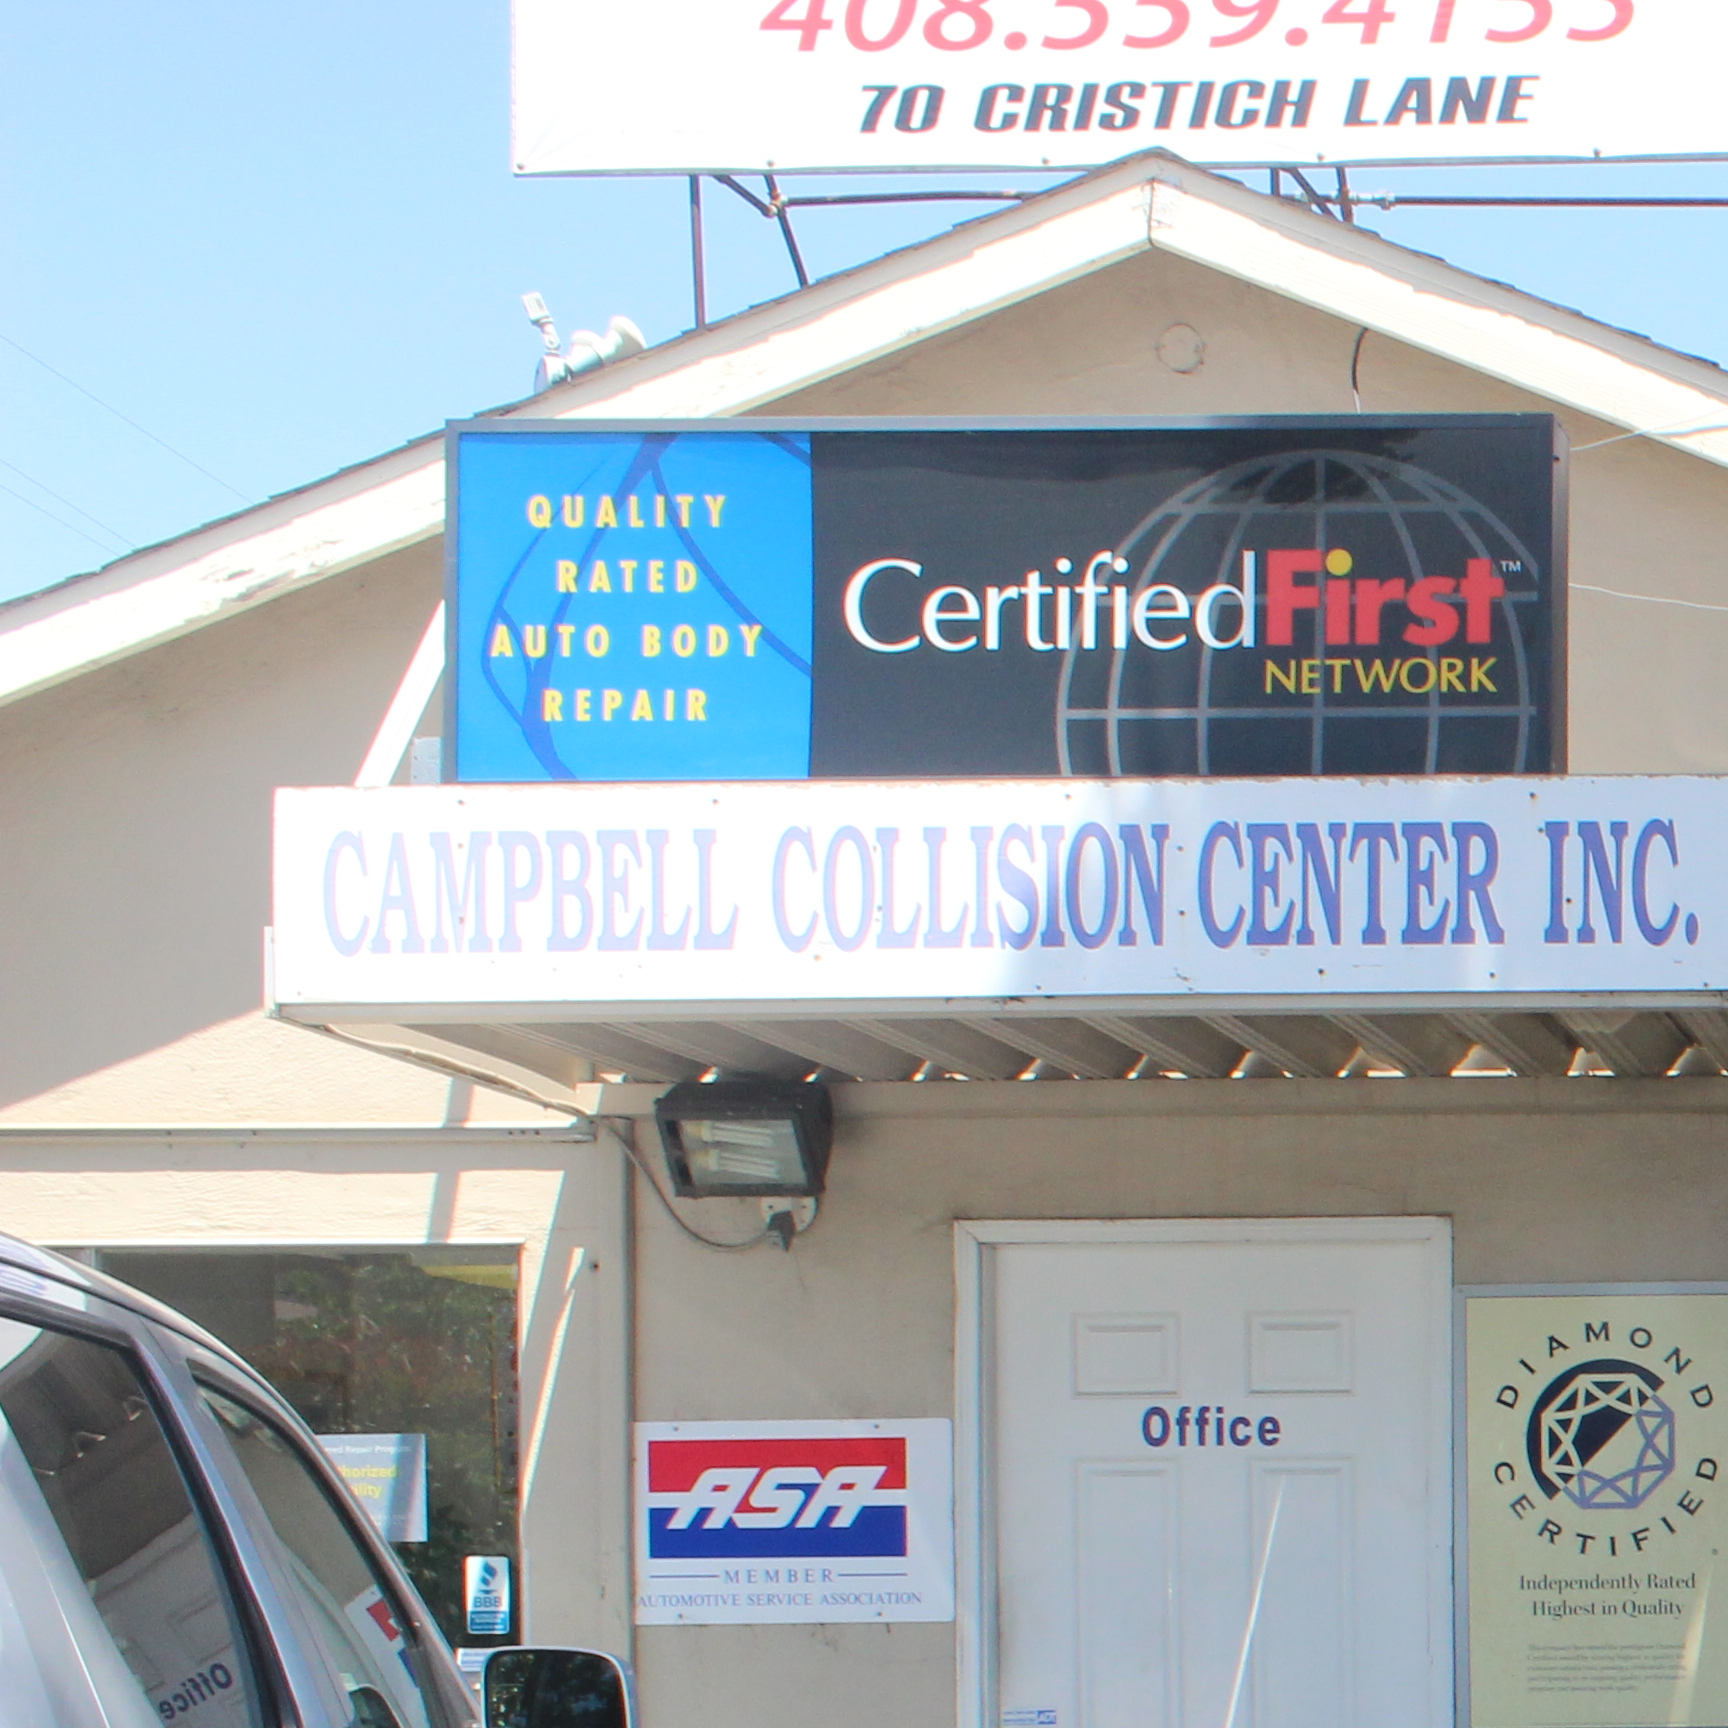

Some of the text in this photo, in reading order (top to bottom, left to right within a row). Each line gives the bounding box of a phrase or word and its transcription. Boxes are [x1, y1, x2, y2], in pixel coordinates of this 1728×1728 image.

[859, 75, 1542, 133] 70 CRISTICH LANE
[526, 495, 727, 528] QUALITY
[557, 560, 699, 592] RATED
[490, 625, 764, 657] AUTO BODY
[1264, 657, 1498, 694] NETWORK
[542, 689, 707, 721] REPAIR
[321, 817, 1700, 956] CAMPBELL COLLISION CENTER INC.
[1496, 1321, 1714, 1410] DIAMOND
[1141, 1405, 1282, 1447] Office
[666, 1464, 888, 1530] ASA
[1493, 1457, 1720, 1557] CERTIFIED
[723, 1568, 835, 1585] MEMBER
[1519, 1572, 1697, 1595] Independently Rated
[474, 1597, 502, 1608] BBB
[637, 1591, 923, 1609] AUTOMOTIVE SERVICE ASSOCIATION
[1531, 1599, 1685, 1621] Highest in Quality
